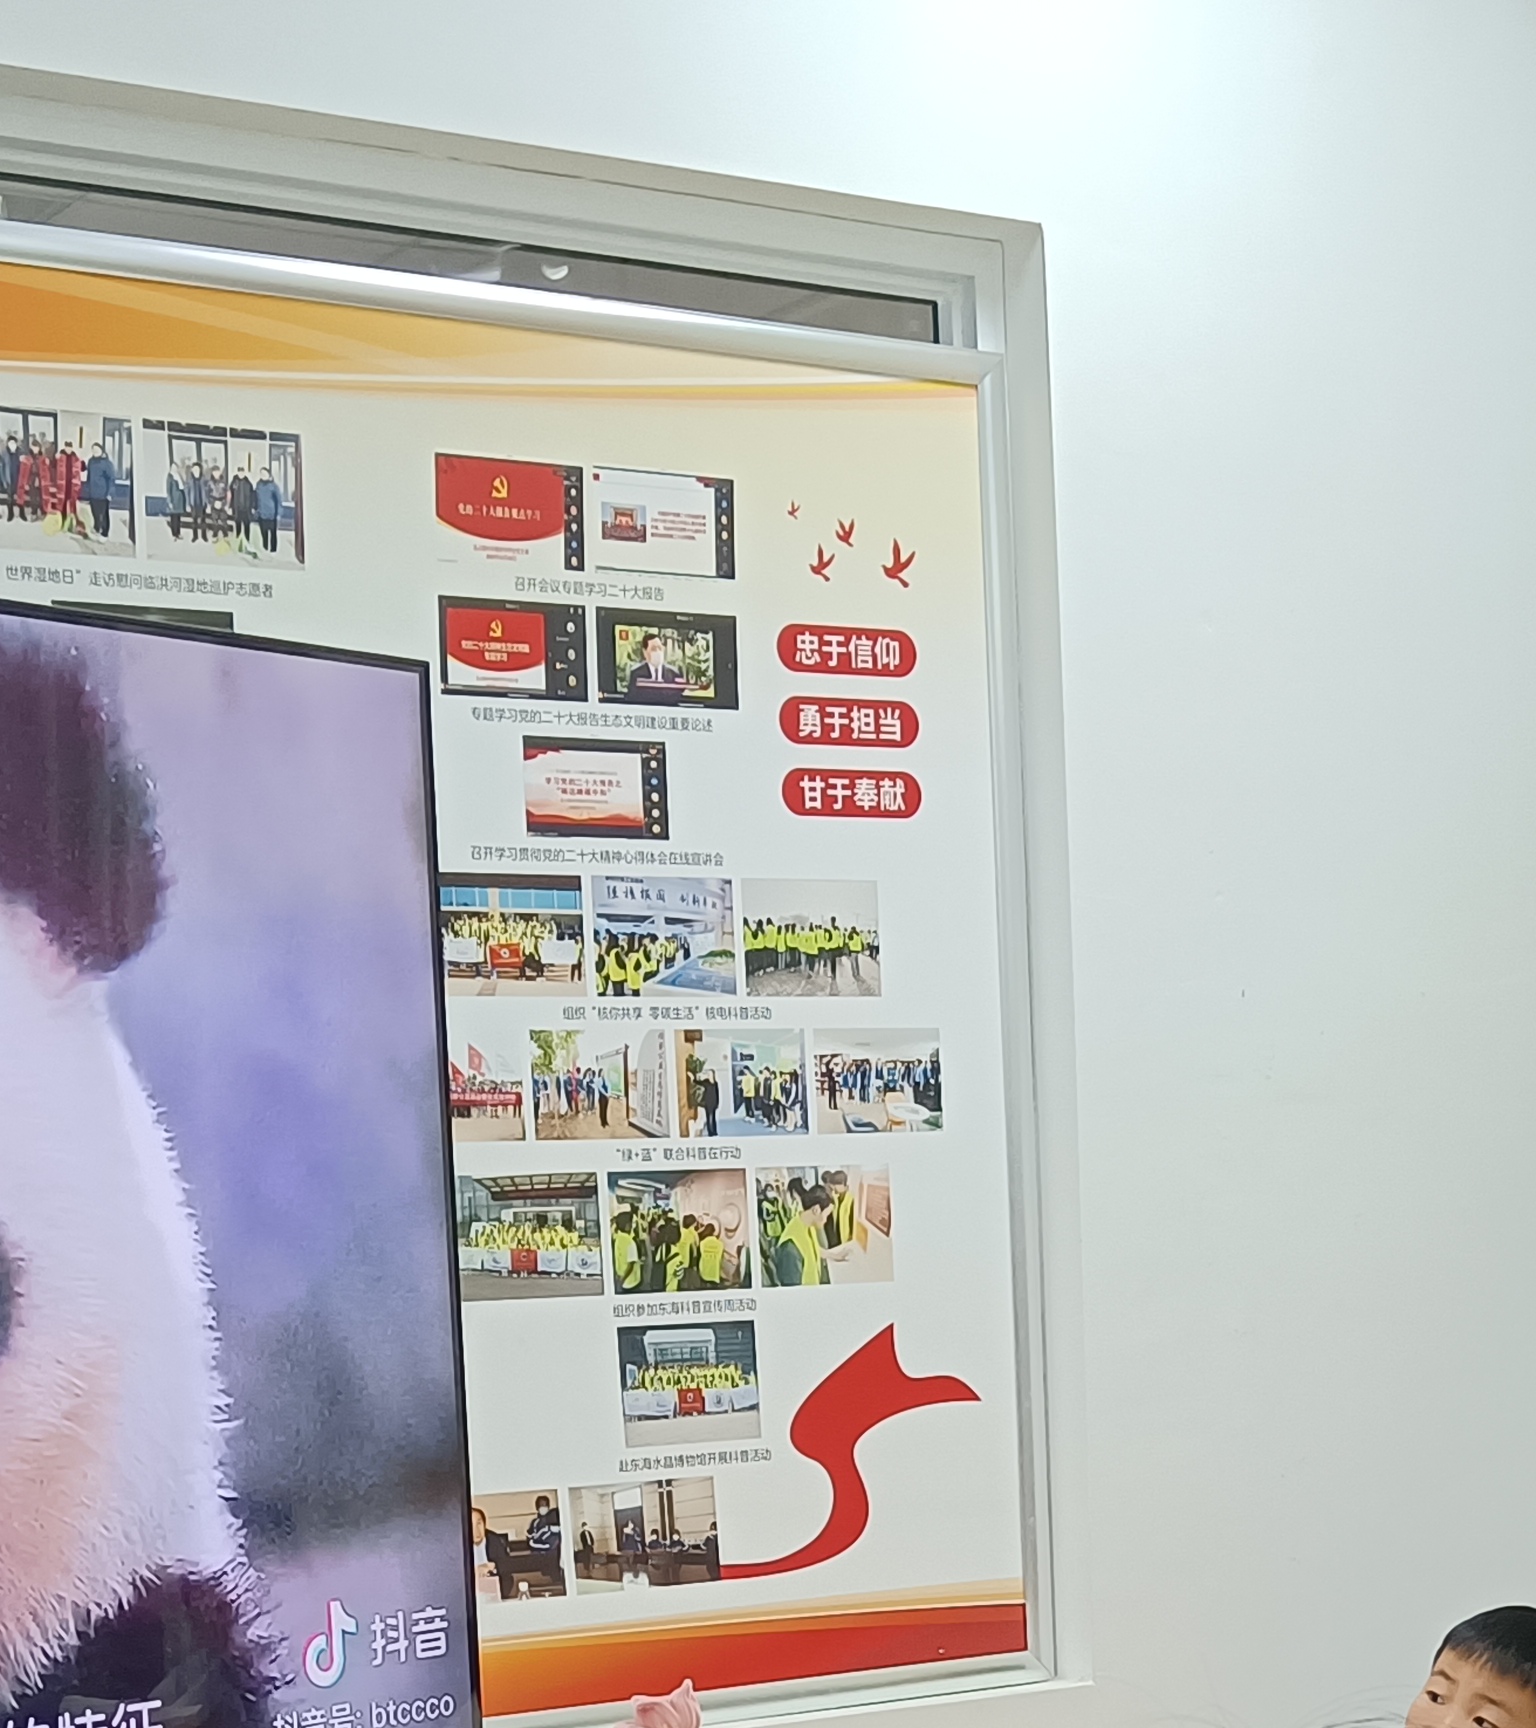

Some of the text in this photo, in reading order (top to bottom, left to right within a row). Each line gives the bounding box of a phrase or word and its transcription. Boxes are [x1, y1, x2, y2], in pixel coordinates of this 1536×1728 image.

[514, 576, 664, 601] 召开会议专题学习二十大报告
[795, 631, 900, 671] 忠于信仰
[471, 706, 713, 733] 专题学习党的二十大报告生态文明建设重要论述
[798, 704, 901, 741] 勇于担当
[799, 774, 905, 811] 甘于奉献
[370, 1605, 448, 1667] 抖音
